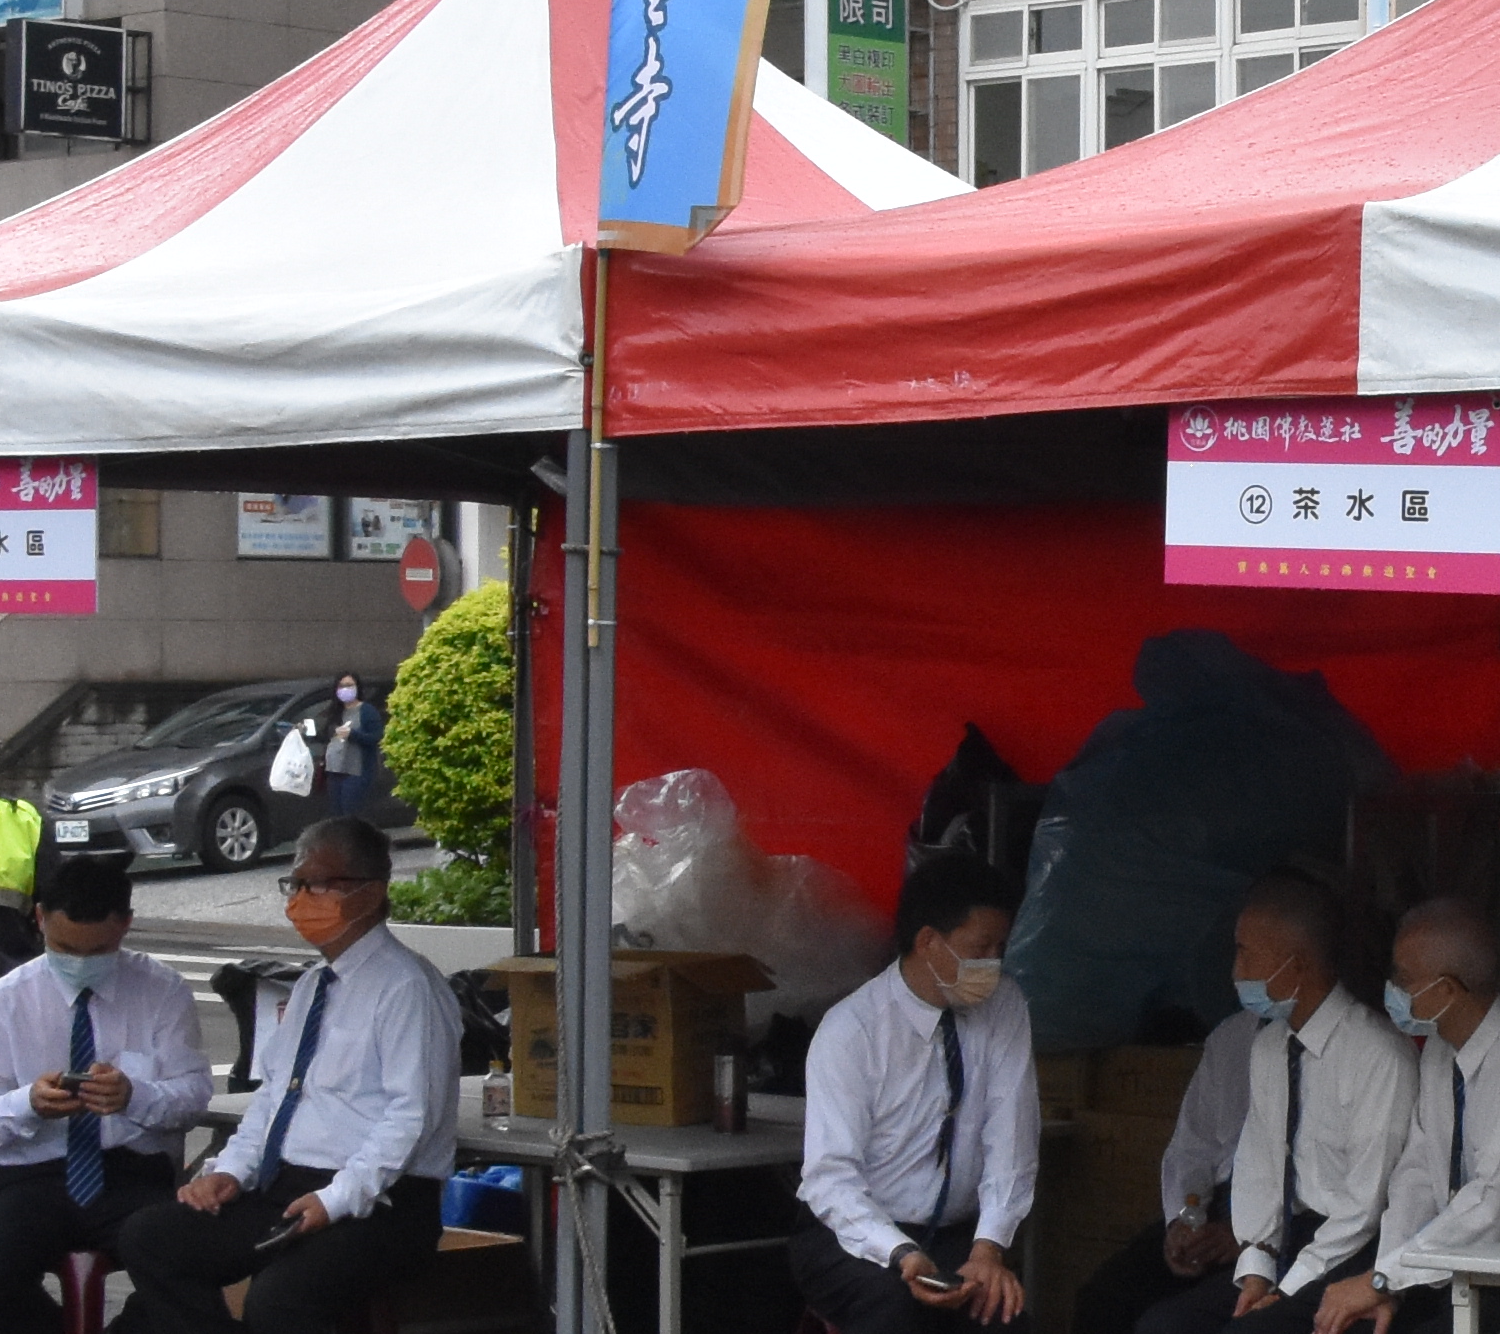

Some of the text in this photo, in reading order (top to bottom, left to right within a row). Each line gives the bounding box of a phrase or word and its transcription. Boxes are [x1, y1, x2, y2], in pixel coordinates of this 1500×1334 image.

[77, 84, 117, 100] PIZZA
[1291, 487, 1431, 523] 茶水區
